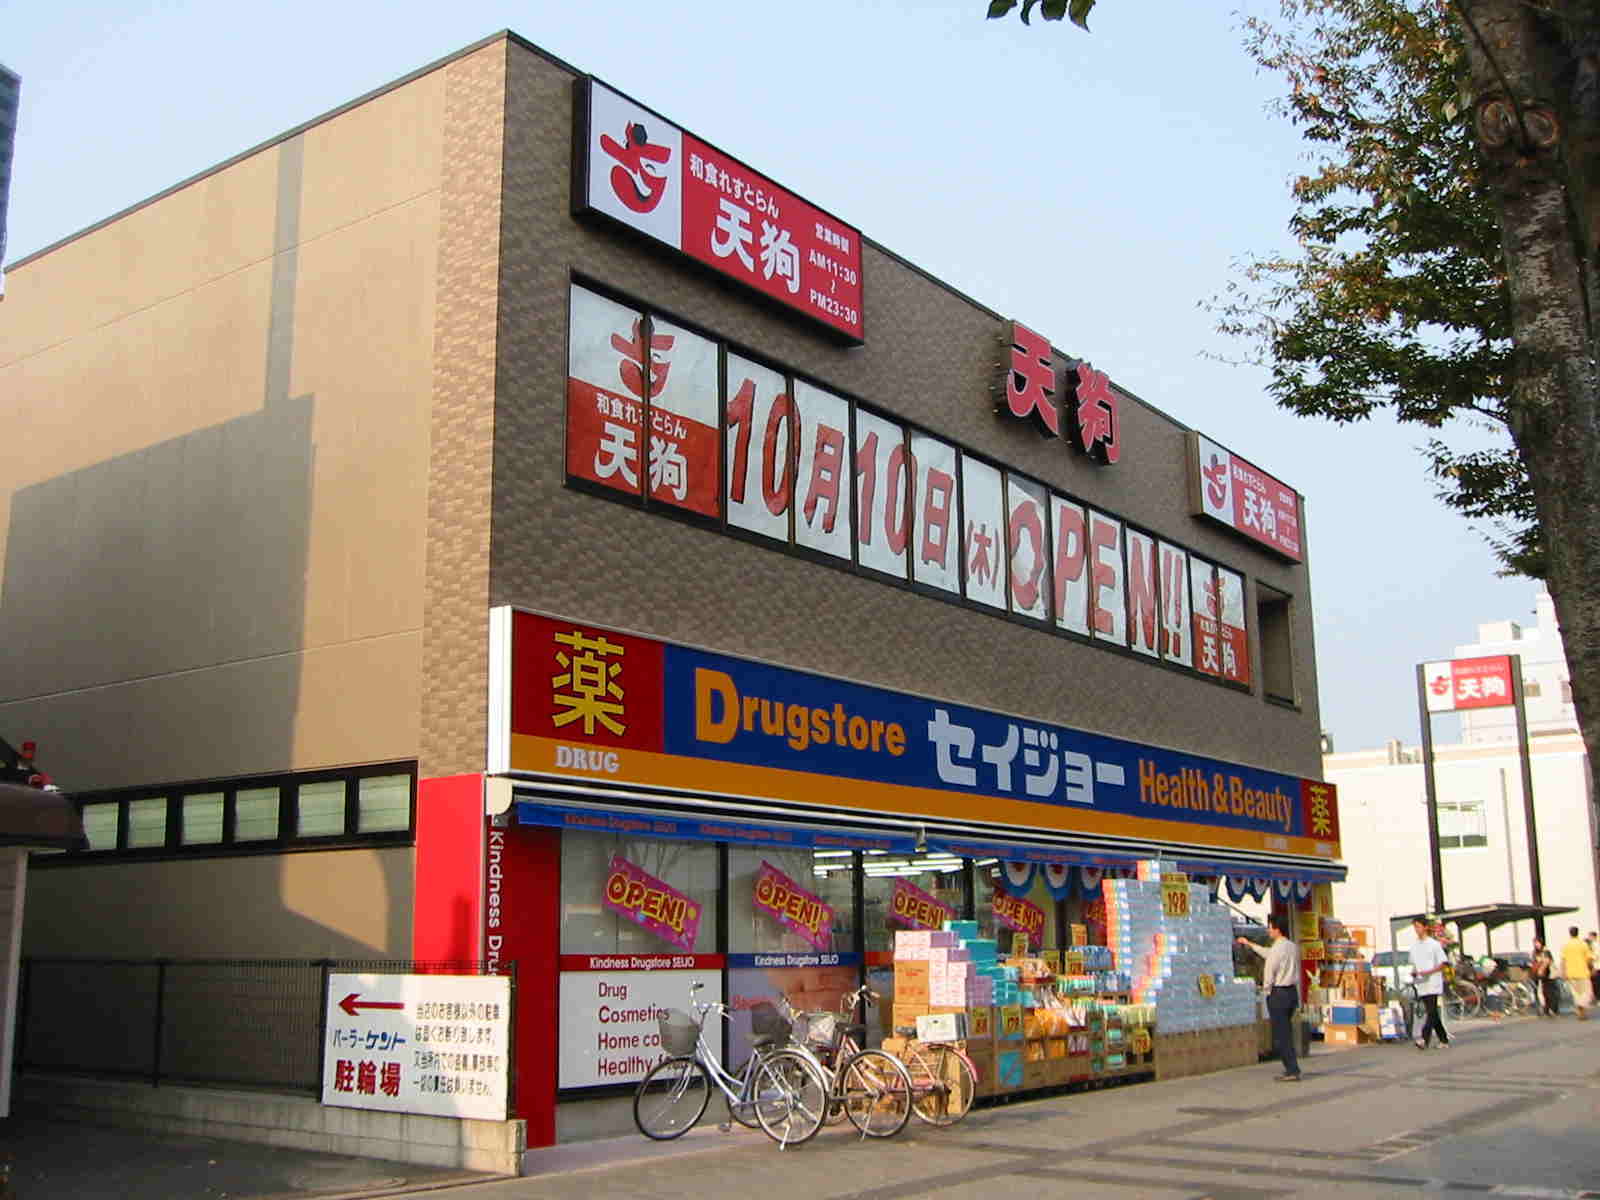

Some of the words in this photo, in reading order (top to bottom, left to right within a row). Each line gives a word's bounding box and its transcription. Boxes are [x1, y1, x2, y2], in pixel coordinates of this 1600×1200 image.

[689, 153, 780, 219] 和食れすとらん
[710, 197, 800, 294] 天狗
[809, 248, 857, 286] AM11:30
[810, 288, 857, 325] PM23:30
[1006, 321, 1121, 465] 天狗
[593, 421, 688, 500] 天狗
[551, 630, 626, 737] 薬
[695, 667, 906, 757] Drugstore
[928, 708, 1126, 804] セイジョー
[555, 744, 620, 773] DRUG
[1311, 786, 1331, 836] 薬
[488, 830, 504, 929] Kindness
[590, 956, 629, 969] Kindness
[631, 957, 671, 971] Drugstore
[598, 982, 627, 1000] Drug
[598, 1002, 670, 1023] Cosmetics
[598, 1032, 640, 1050] Home
[334, 1059, 400, 1097] 駐輪場
[598, 1056, 653, 1077] Healthy
